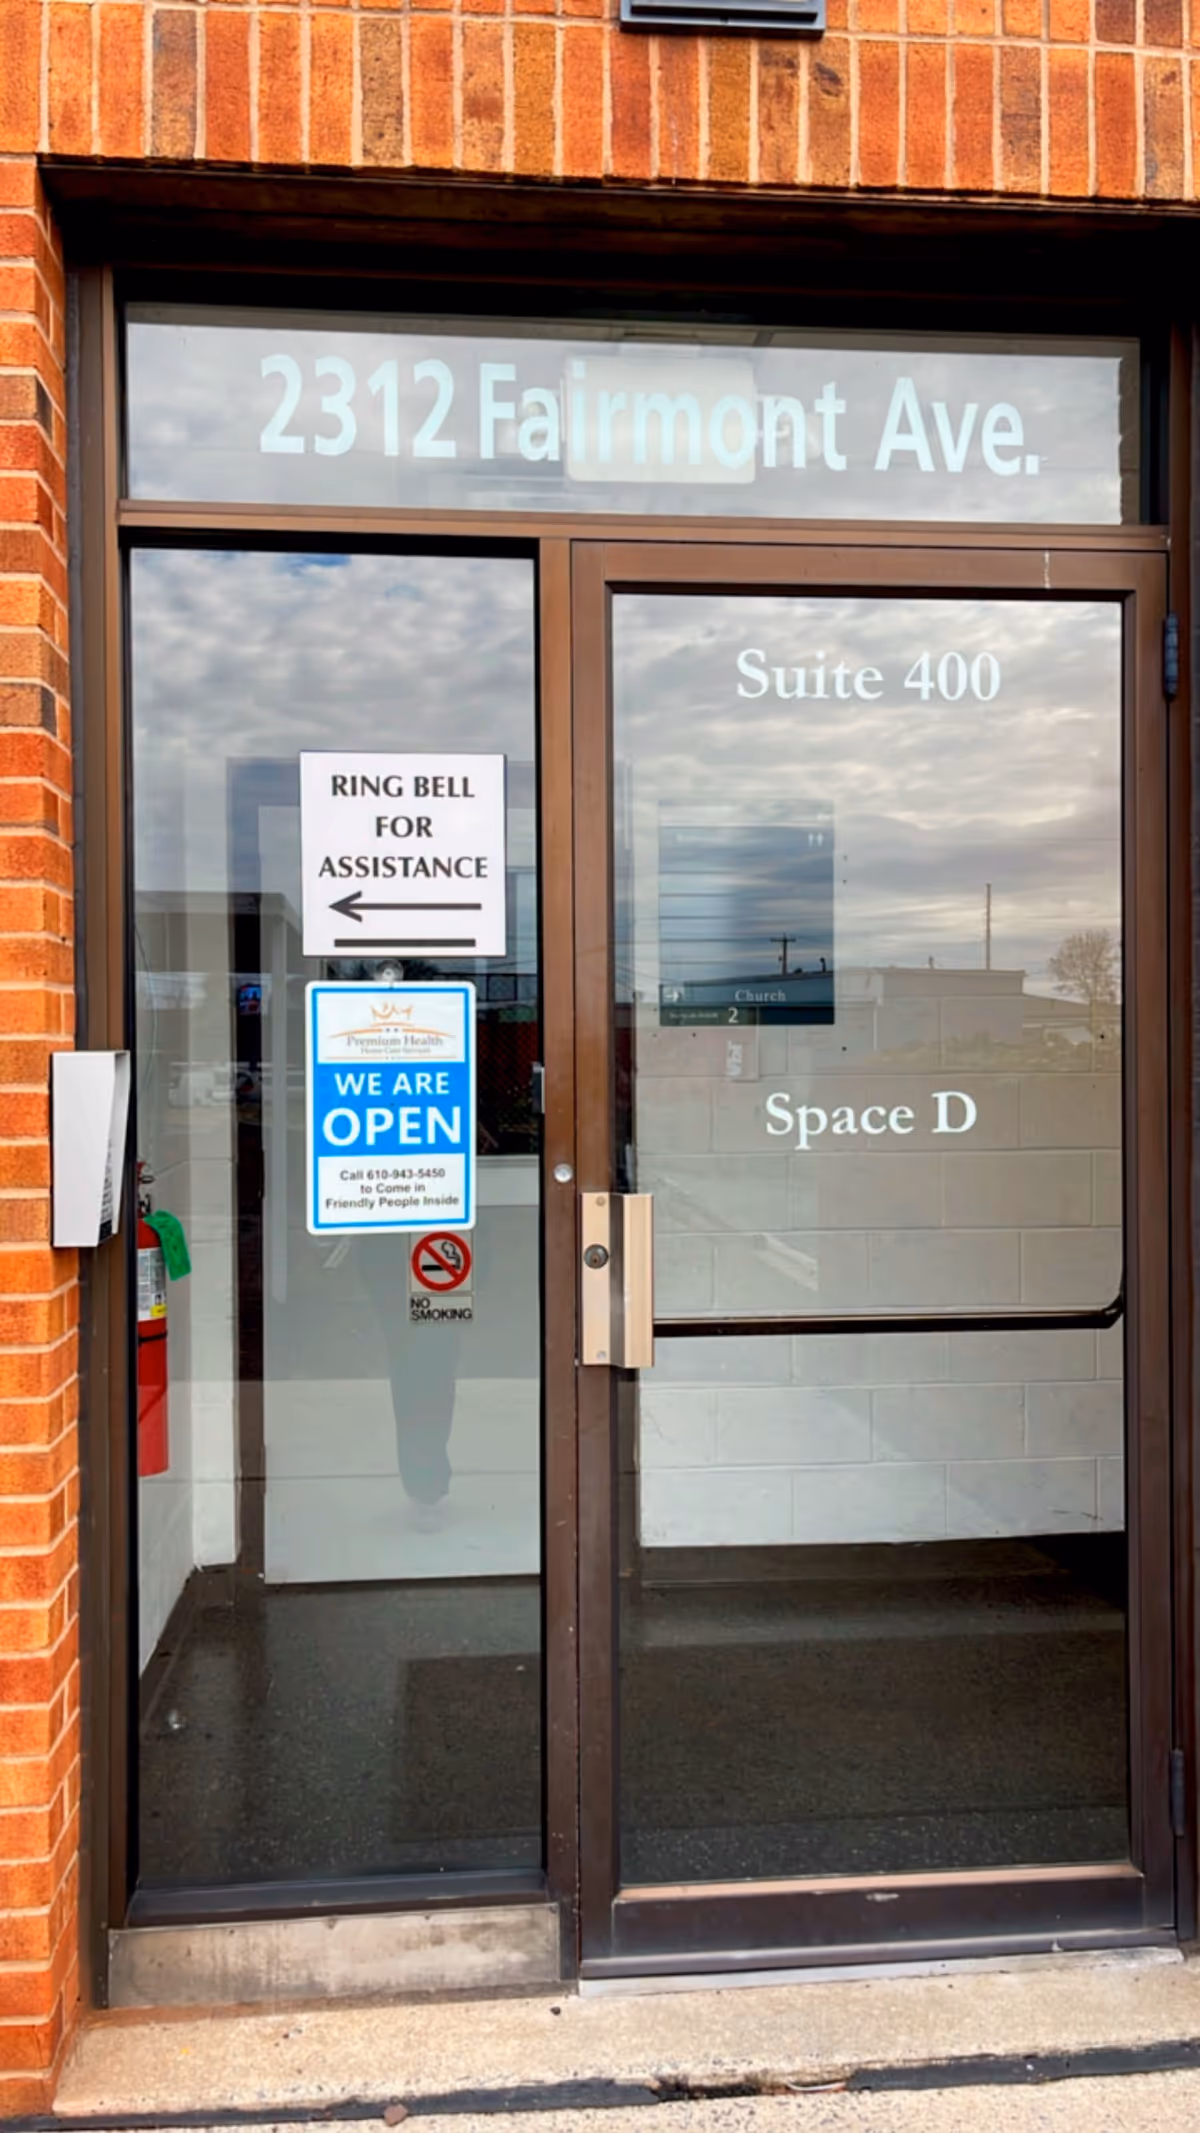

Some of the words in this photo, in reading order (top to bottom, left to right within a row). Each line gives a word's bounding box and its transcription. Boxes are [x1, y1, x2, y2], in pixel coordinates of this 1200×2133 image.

[259, 353, 457, 458] 2312
[479, 360, 847, 471] Fairmont
[874, 376, 1041, 476] Ave.
[736, 648, 884, 700] Suite
[904, 651, 1001, 701] 400
[331, 774, 404, 798] RING
[414, 776, 475, 798] BELL
[376, 816, 433, 838] FOR
[318, 856, 489, 879] ASSISTANCE
[734, 989, 787, 1002] Church
[728, 1007, 739, 1023] 2
[346, 1034, 401, 1047] Premium
[404, 1034, 443, 1047] Health
[334, 1072, 382, 1096] WE
[393, 1072, 450, 1095] ARE
[322, 1106, 461, 1146] OPEN
[765, 1092, 915, 1150] Space
[931, 1091, 977, 1133] D
[340, 1170, 364, 1181] Call
[367, 1168, 446, 1180] 610-943-5450
[360, 1184, 373, 1194] to
[376, 1183, 411, 1194] Come
[414, 1182, 426, 1192] in
[326, 1198, 375, 1210] Friendly
[379, 1196, 420, 1208] People
[423, 1194, 460, 1206] Inside
[410, 1297, 431, 1309] NO
[411, 1308, 473, 1321] SMOKING
